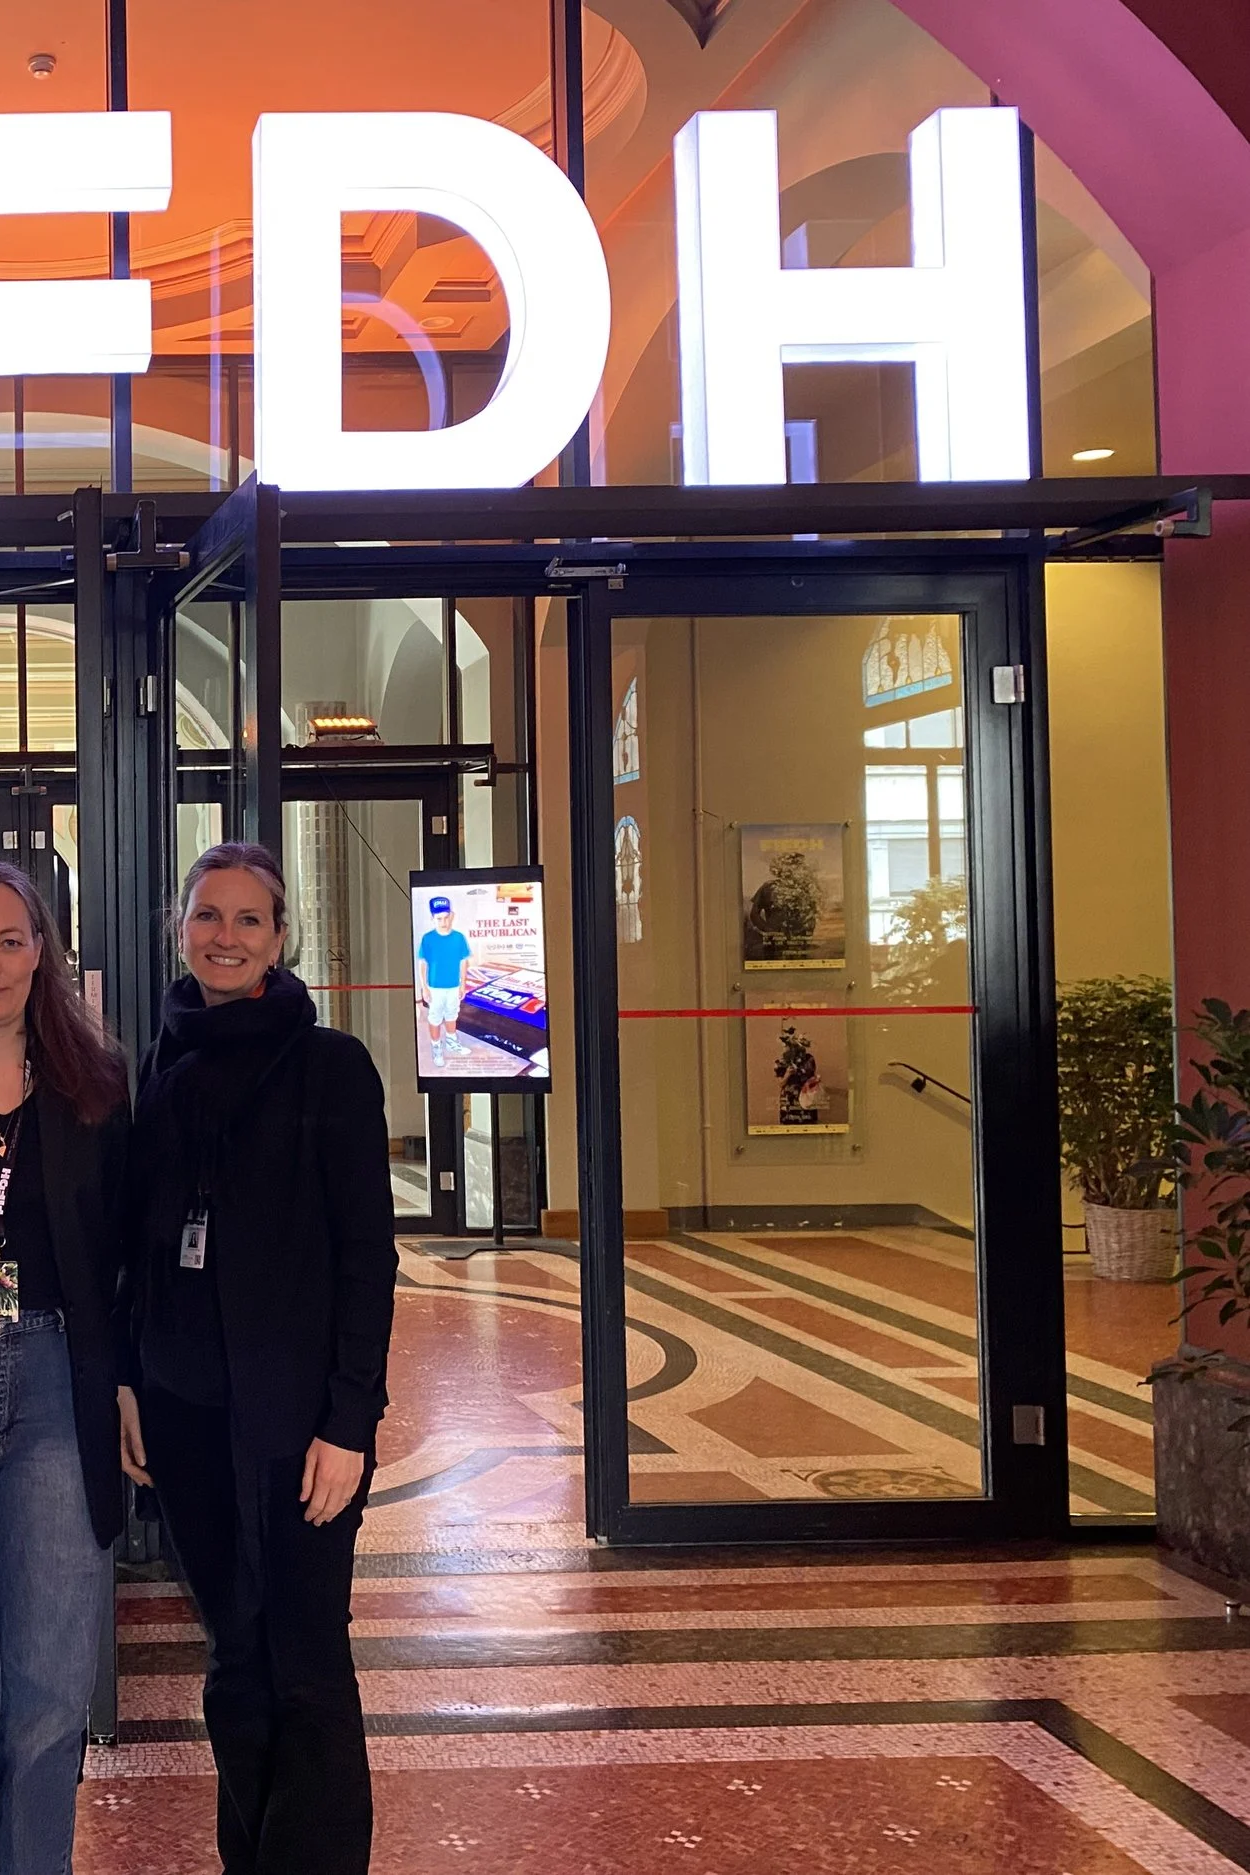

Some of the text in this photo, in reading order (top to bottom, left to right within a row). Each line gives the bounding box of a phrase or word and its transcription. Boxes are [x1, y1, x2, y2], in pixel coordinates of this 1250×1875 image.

[476, 918, 530, 928] THE LAST
[468, 928, 538, 938] REPUBLICAN
